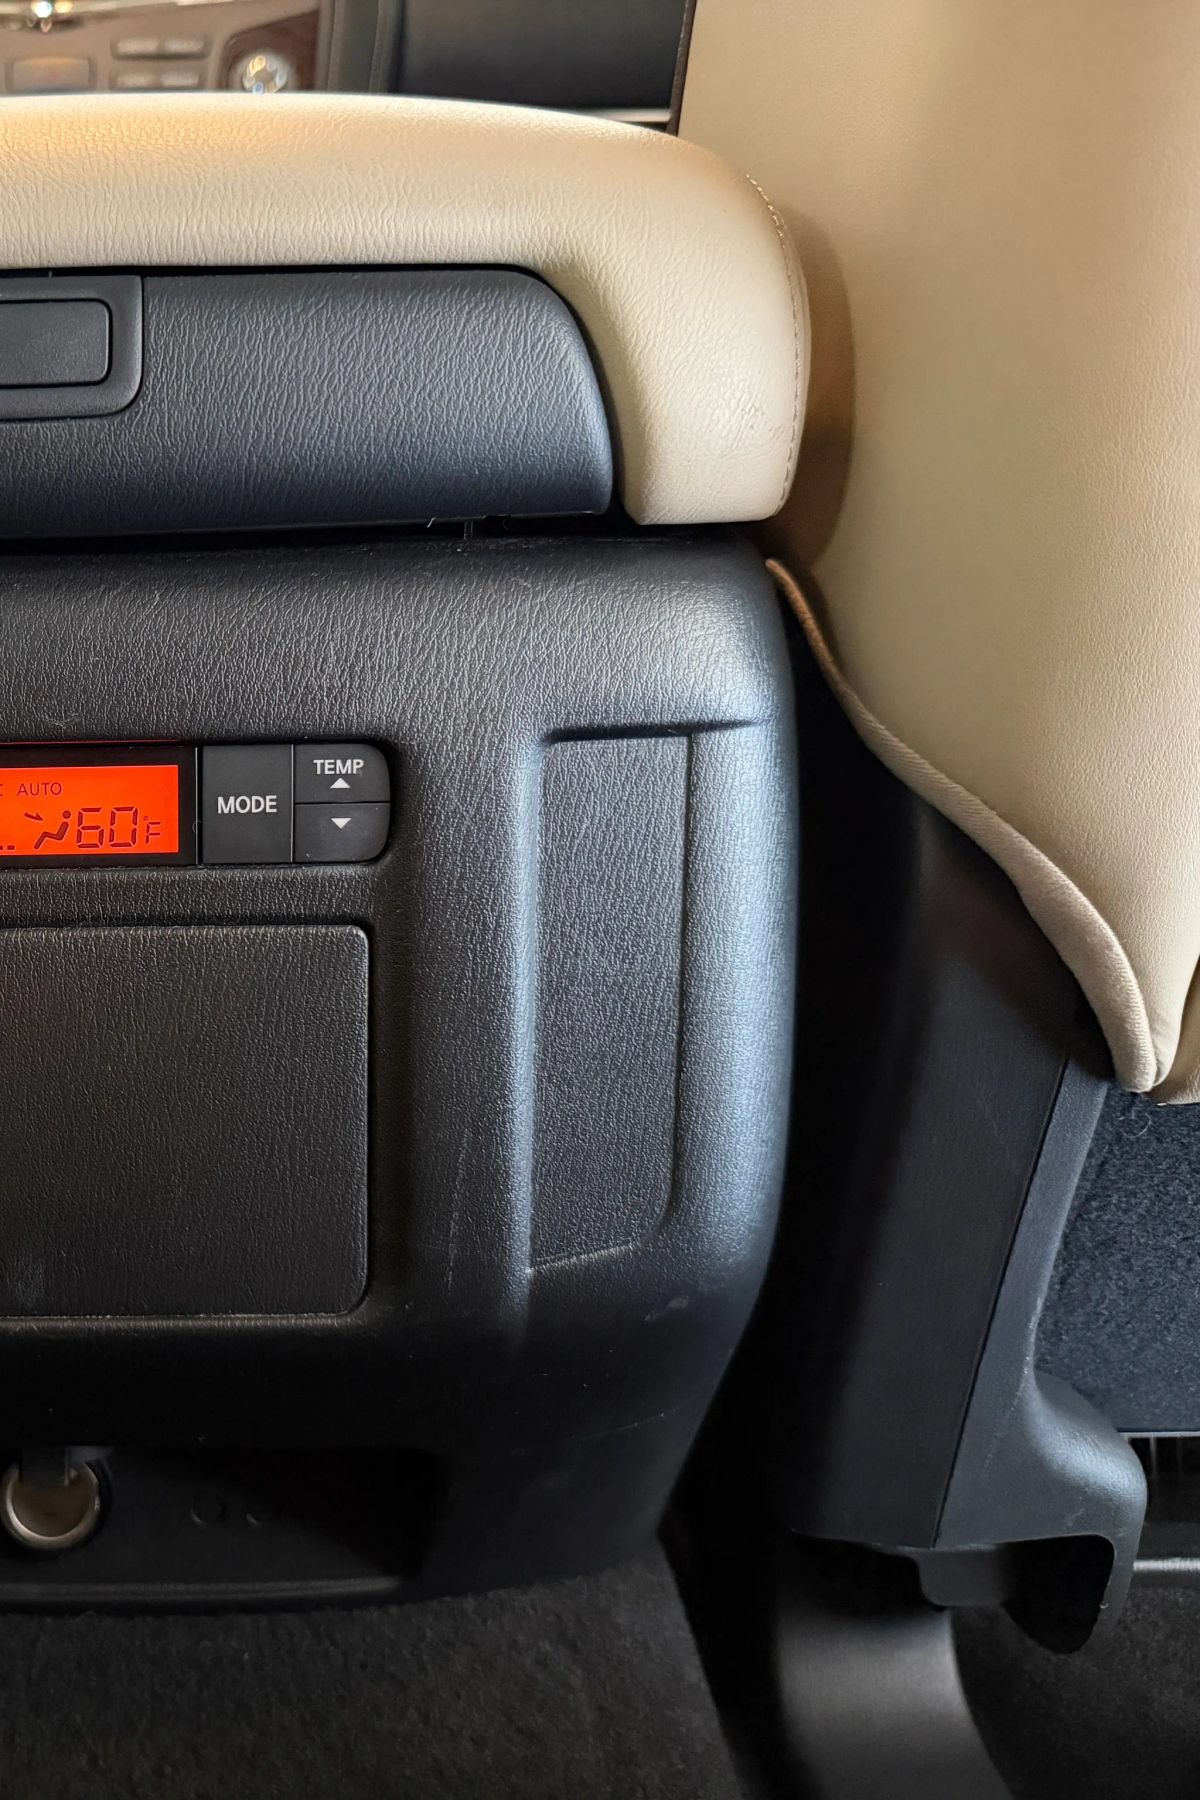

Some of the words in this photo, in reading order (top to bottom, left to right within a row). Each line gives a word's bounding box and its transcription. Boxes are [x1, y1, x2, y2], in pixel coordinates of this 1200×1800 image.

[313, 759, 365, 775] TEMP
[17, 782, 62, 797] AUTO
[217, 795, 278, 814] MODE
